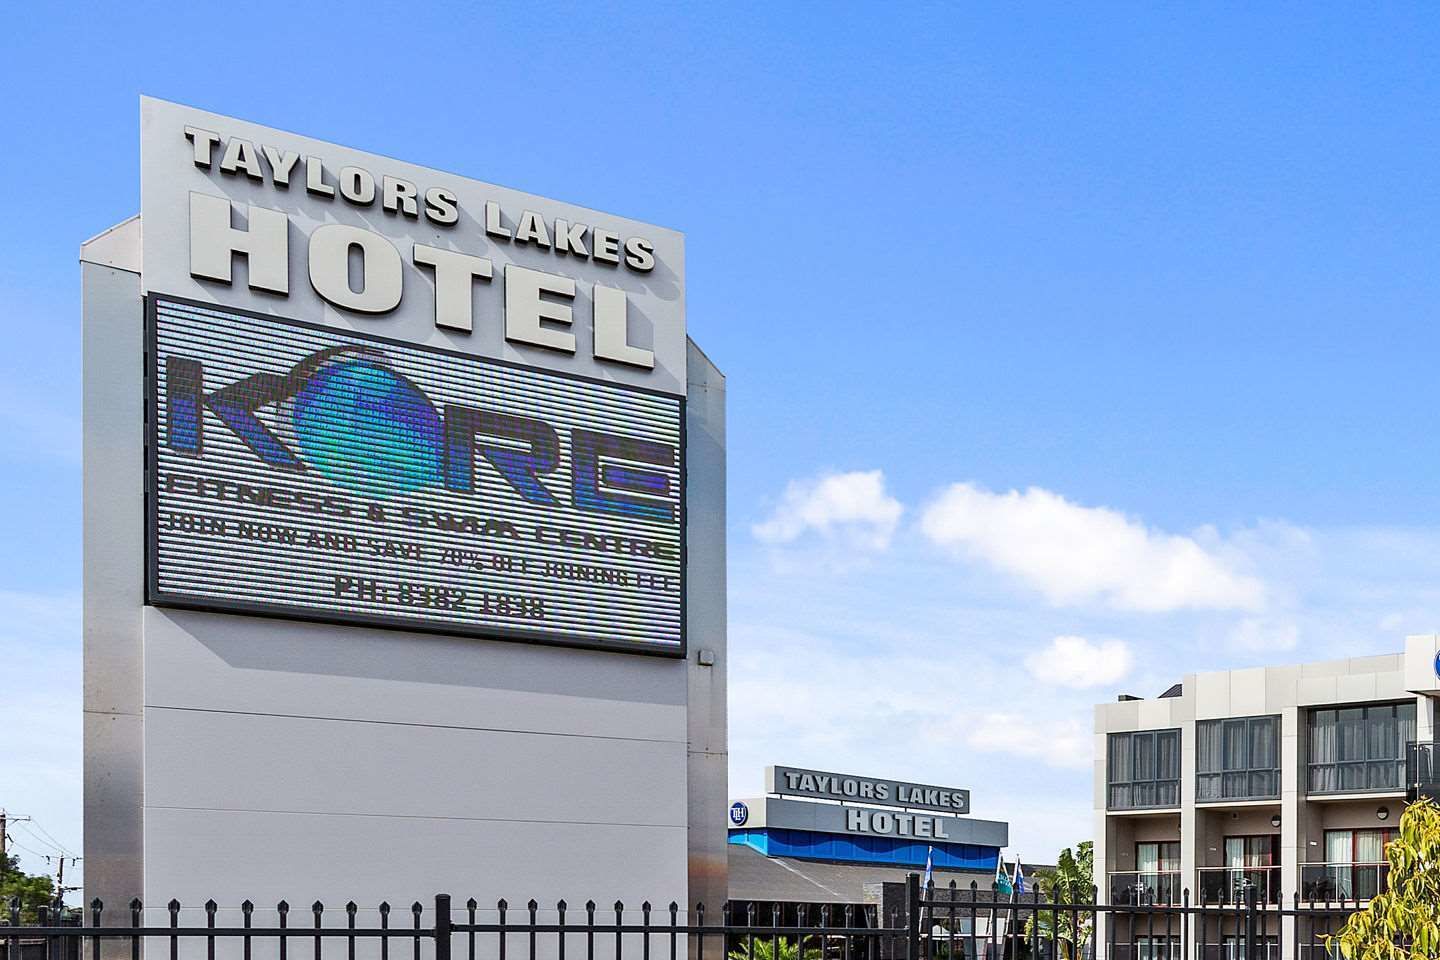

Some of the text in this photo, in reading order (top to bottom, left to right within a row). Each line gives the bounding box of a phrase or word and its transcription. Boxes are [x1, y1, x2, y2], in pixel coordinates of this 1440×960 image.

[185, 124, 656, 273] TAYLORS LAKES
[188, 190, 655, 371] HOTEL
[166, 345, 676, 524] KORE
[785, 772, 964, 809] TAYLORS LAKES
[847, 808, 949, 839] HOTEL
